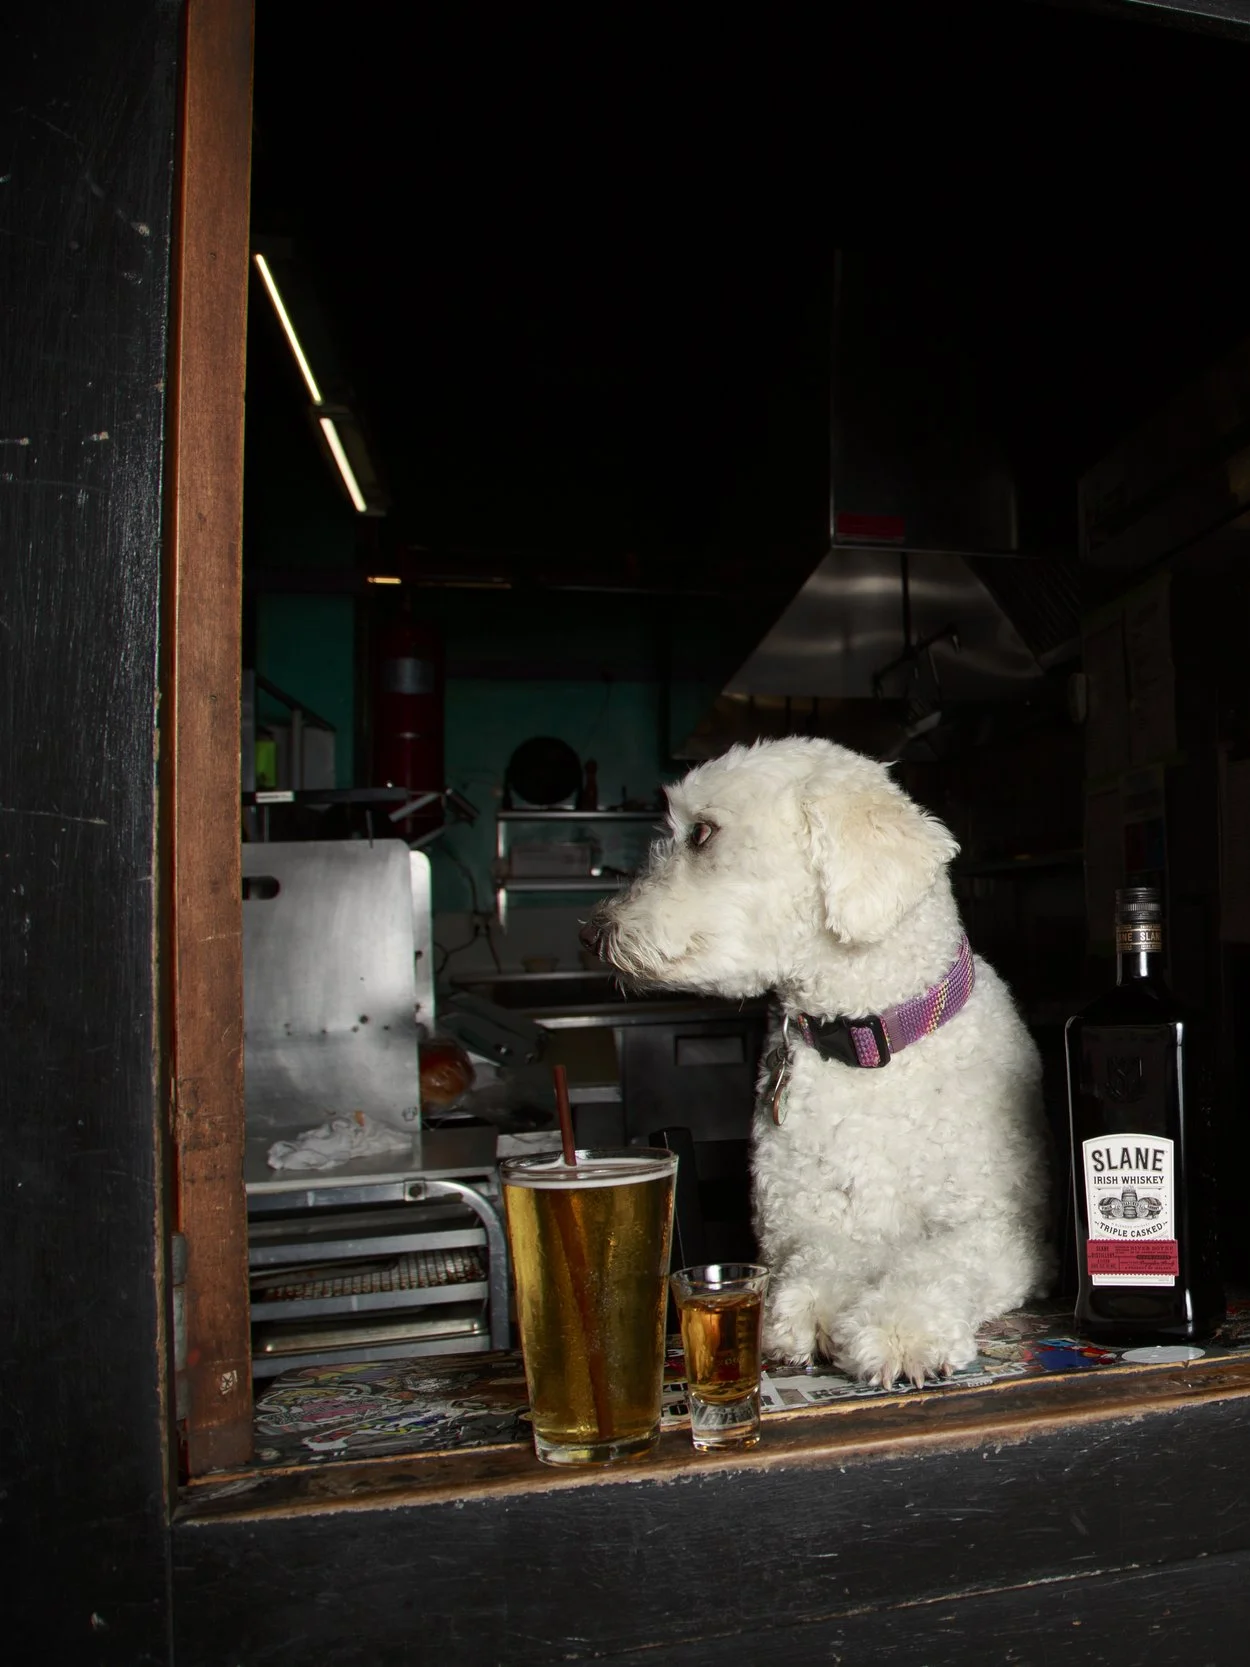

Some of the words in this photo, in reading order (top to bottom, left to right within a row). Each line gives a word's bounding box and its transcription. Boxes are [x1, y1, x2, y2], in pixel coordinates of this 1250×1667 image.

[1091, 1147, 1165, 1172] SLANE
[1093, 1176, 1118, 1185] IRISH
[1121, 1175, 1165, 1185] WHISKEY
[1099, 1222, 1128, 1238] TRIPLE
[1130, 1222, 1163, 1238] CASKED
